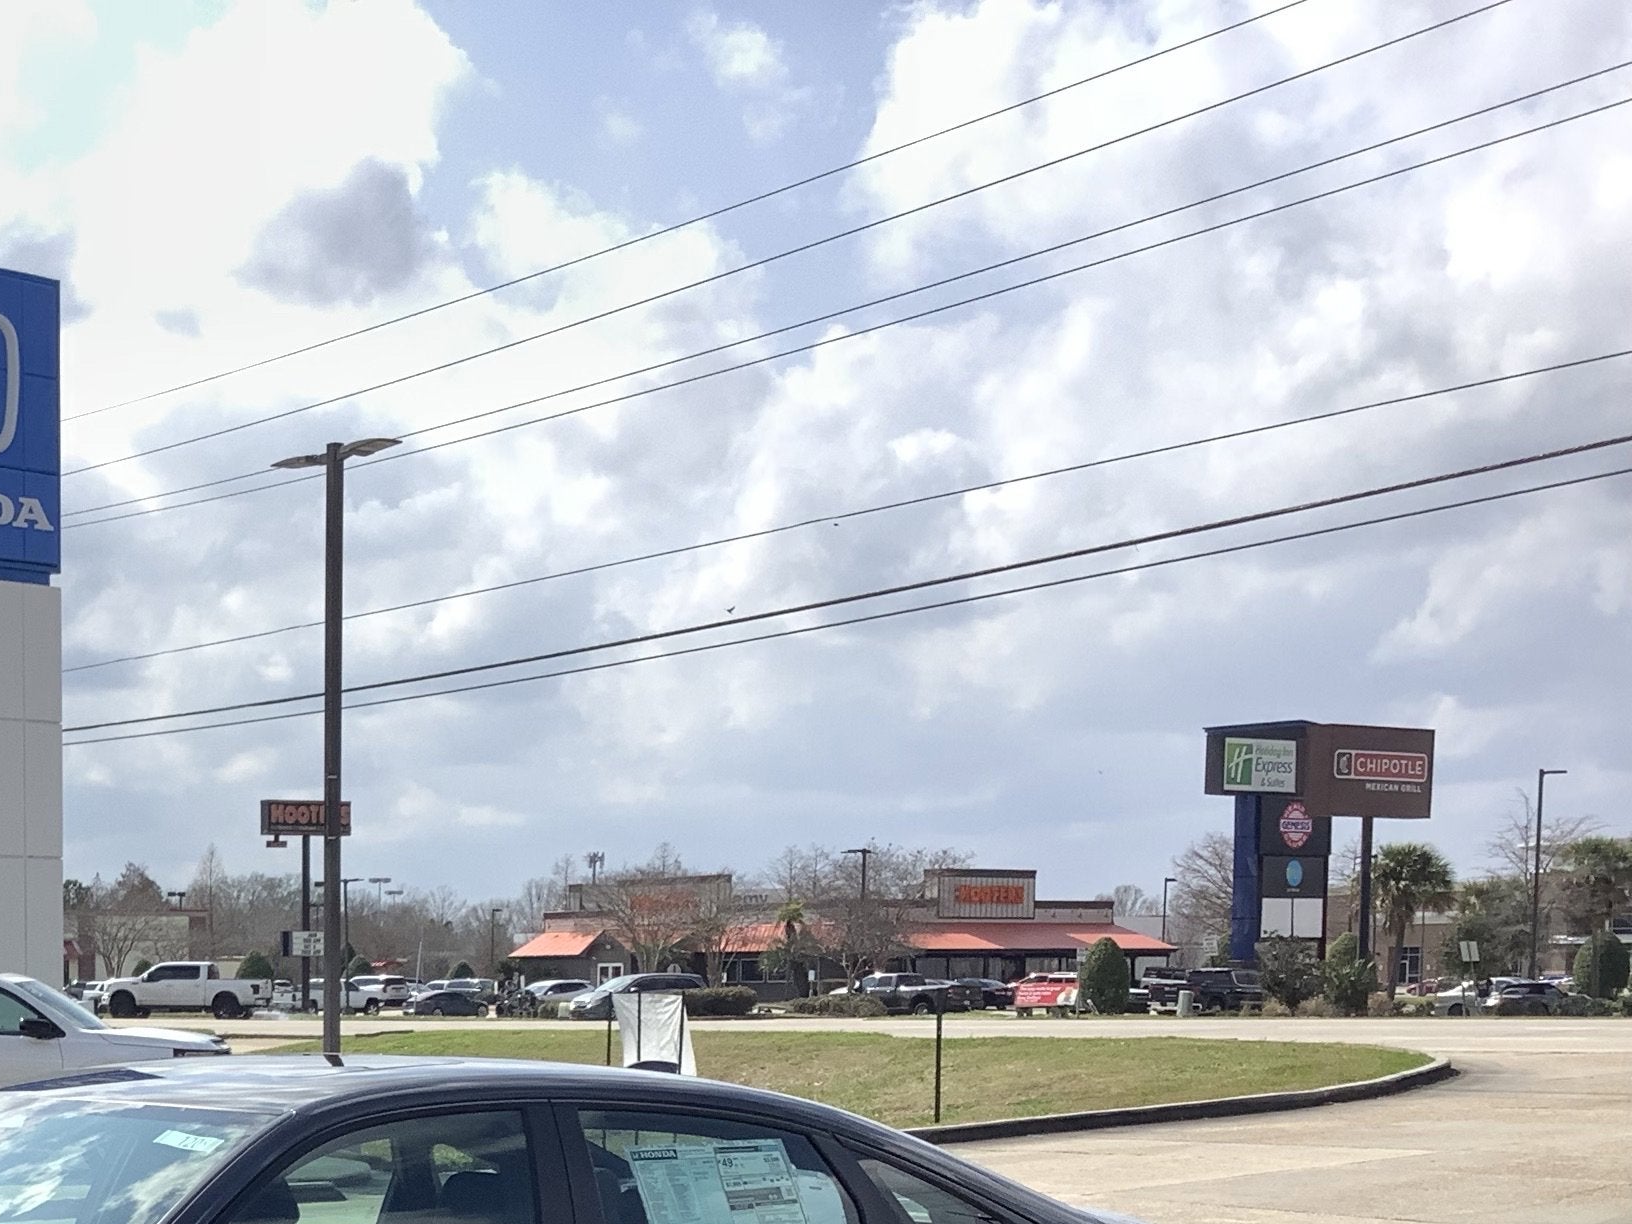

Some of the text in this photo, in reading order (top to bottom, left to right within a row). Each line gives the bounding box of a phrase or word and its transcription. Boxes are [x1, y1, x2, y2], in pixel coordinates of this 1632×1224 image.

[1255, 745, 1294, 758] Holiday Inn
[1255, 757, 1293, 775] Express
[1357, 758, 1424, 775] CHIPOTLE
[1266, 777, 1286, 788] Suites
[1366, 783, 1421, 793] MEXICAN GRILL
[270, 804, 350, 826] HOOTS
[640, 1149, 677, 1160] HONDA
[721, 1157, 733, 1168] 49
